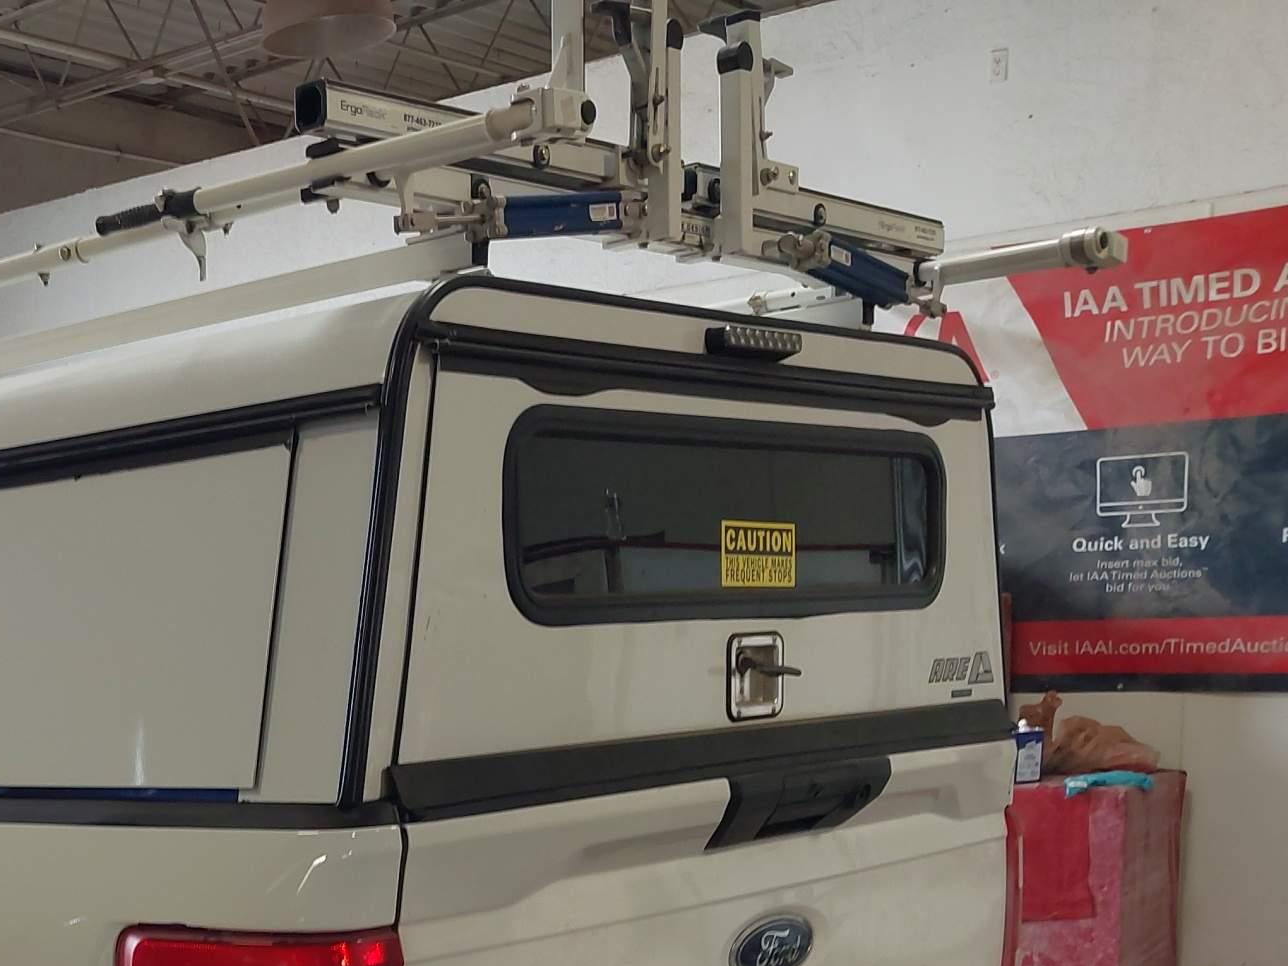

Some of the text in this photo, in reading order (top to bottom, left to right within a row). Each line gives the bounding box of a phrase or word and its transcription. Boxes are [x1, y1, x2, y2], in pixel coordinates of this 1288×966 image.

[1064, 286, 1128, 318] IAA
[1134, 268, 1261, 309] TIMED
[1122, 339, 1192, 369] WAY
[1201, 333, 1245, 360] TO
[726, 528, 792, 553] CAUTION
[1072, 533, 1210, 553] Quick and Easy
[1097, 559, 1129, 569] Insert
[1161, 557, 1183, 568] bid,
[726, 569, 792, 584] FREQUENT STOPS
[1069, 571, 1083, 582] let
[1087, 571, 1109, 580] IAA
[1111, 570, 1147, 580] Timed
[1105, 582, 1124, 592] bid
[1128, 582, 1144, 592] for
[1029, 641, 1069, 656] Visit
